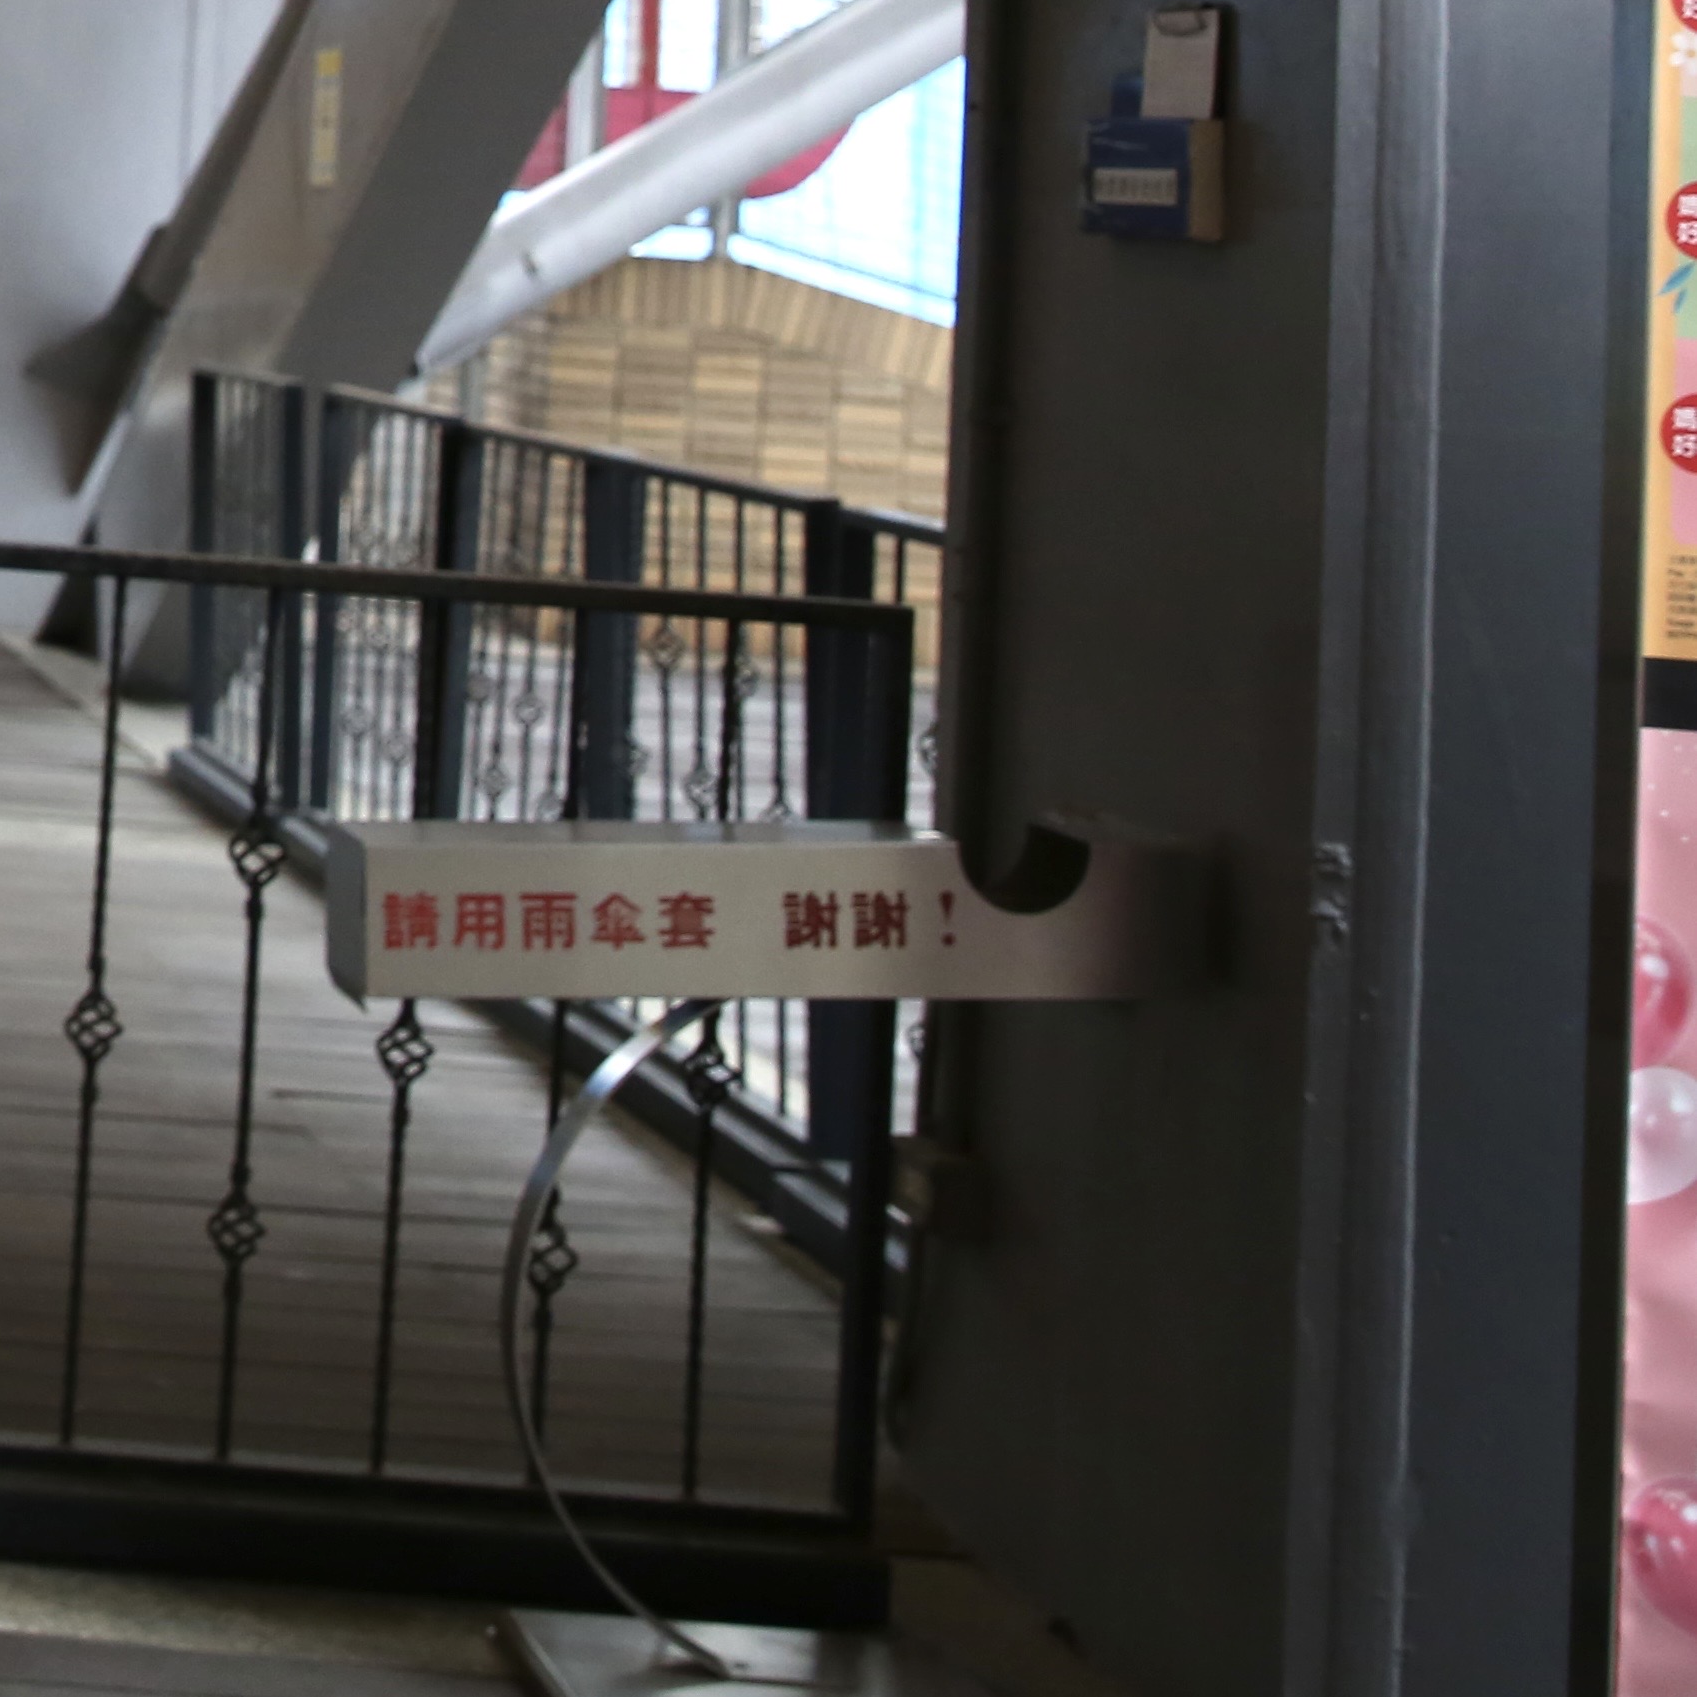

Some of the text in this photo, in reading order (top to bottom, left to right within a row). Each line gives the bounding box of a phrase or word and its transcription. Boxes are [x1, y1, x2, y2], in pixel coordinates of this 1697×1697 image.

[382, 891, 715, 951] 請用雨傘套
